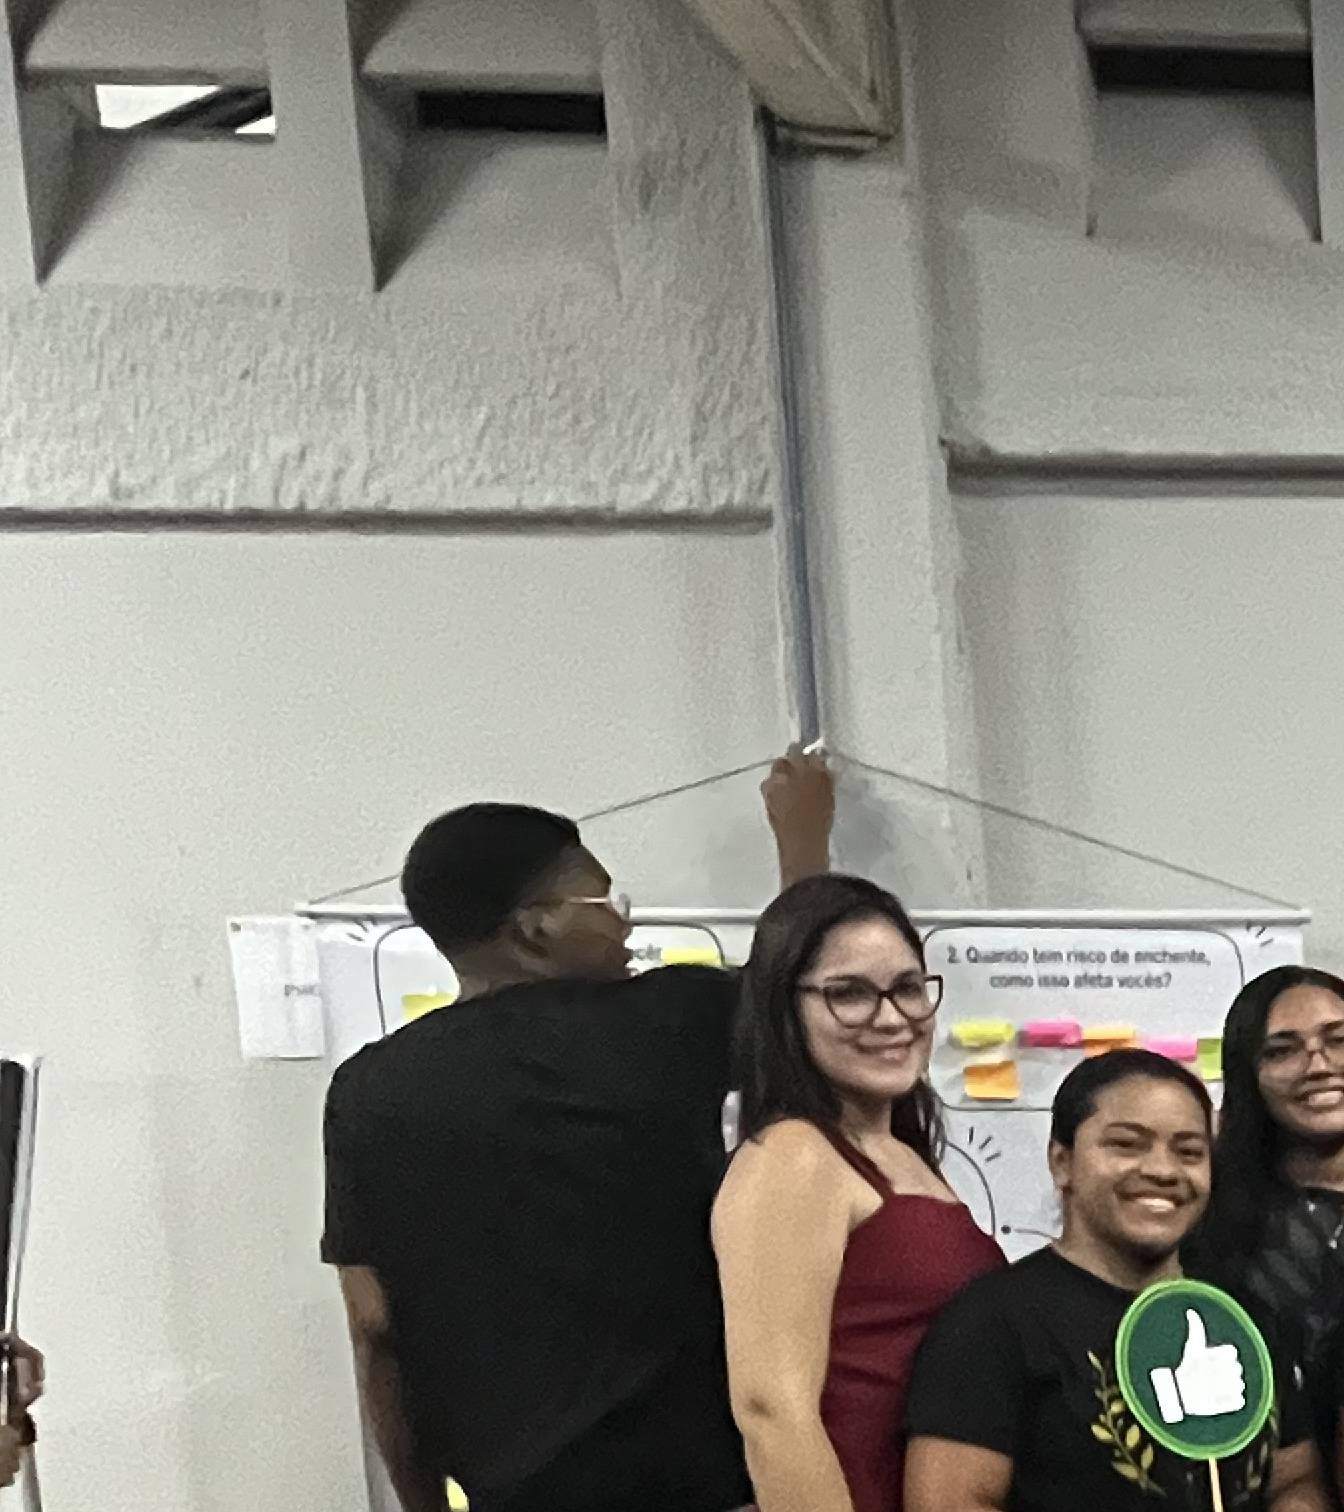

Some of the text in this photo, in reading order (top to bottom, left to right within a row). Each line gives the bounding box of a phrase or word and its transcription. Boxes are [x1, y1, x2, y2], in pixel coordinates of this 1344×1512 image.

[966, 945, 1029, 963] Quando
[1033, 947, 1064, 963] tem
[1067, 948, 1106, 963] risco
[1111, 947, 1129, 963] de
[990, 971, 1171, 988] como isso afeta vocês?
